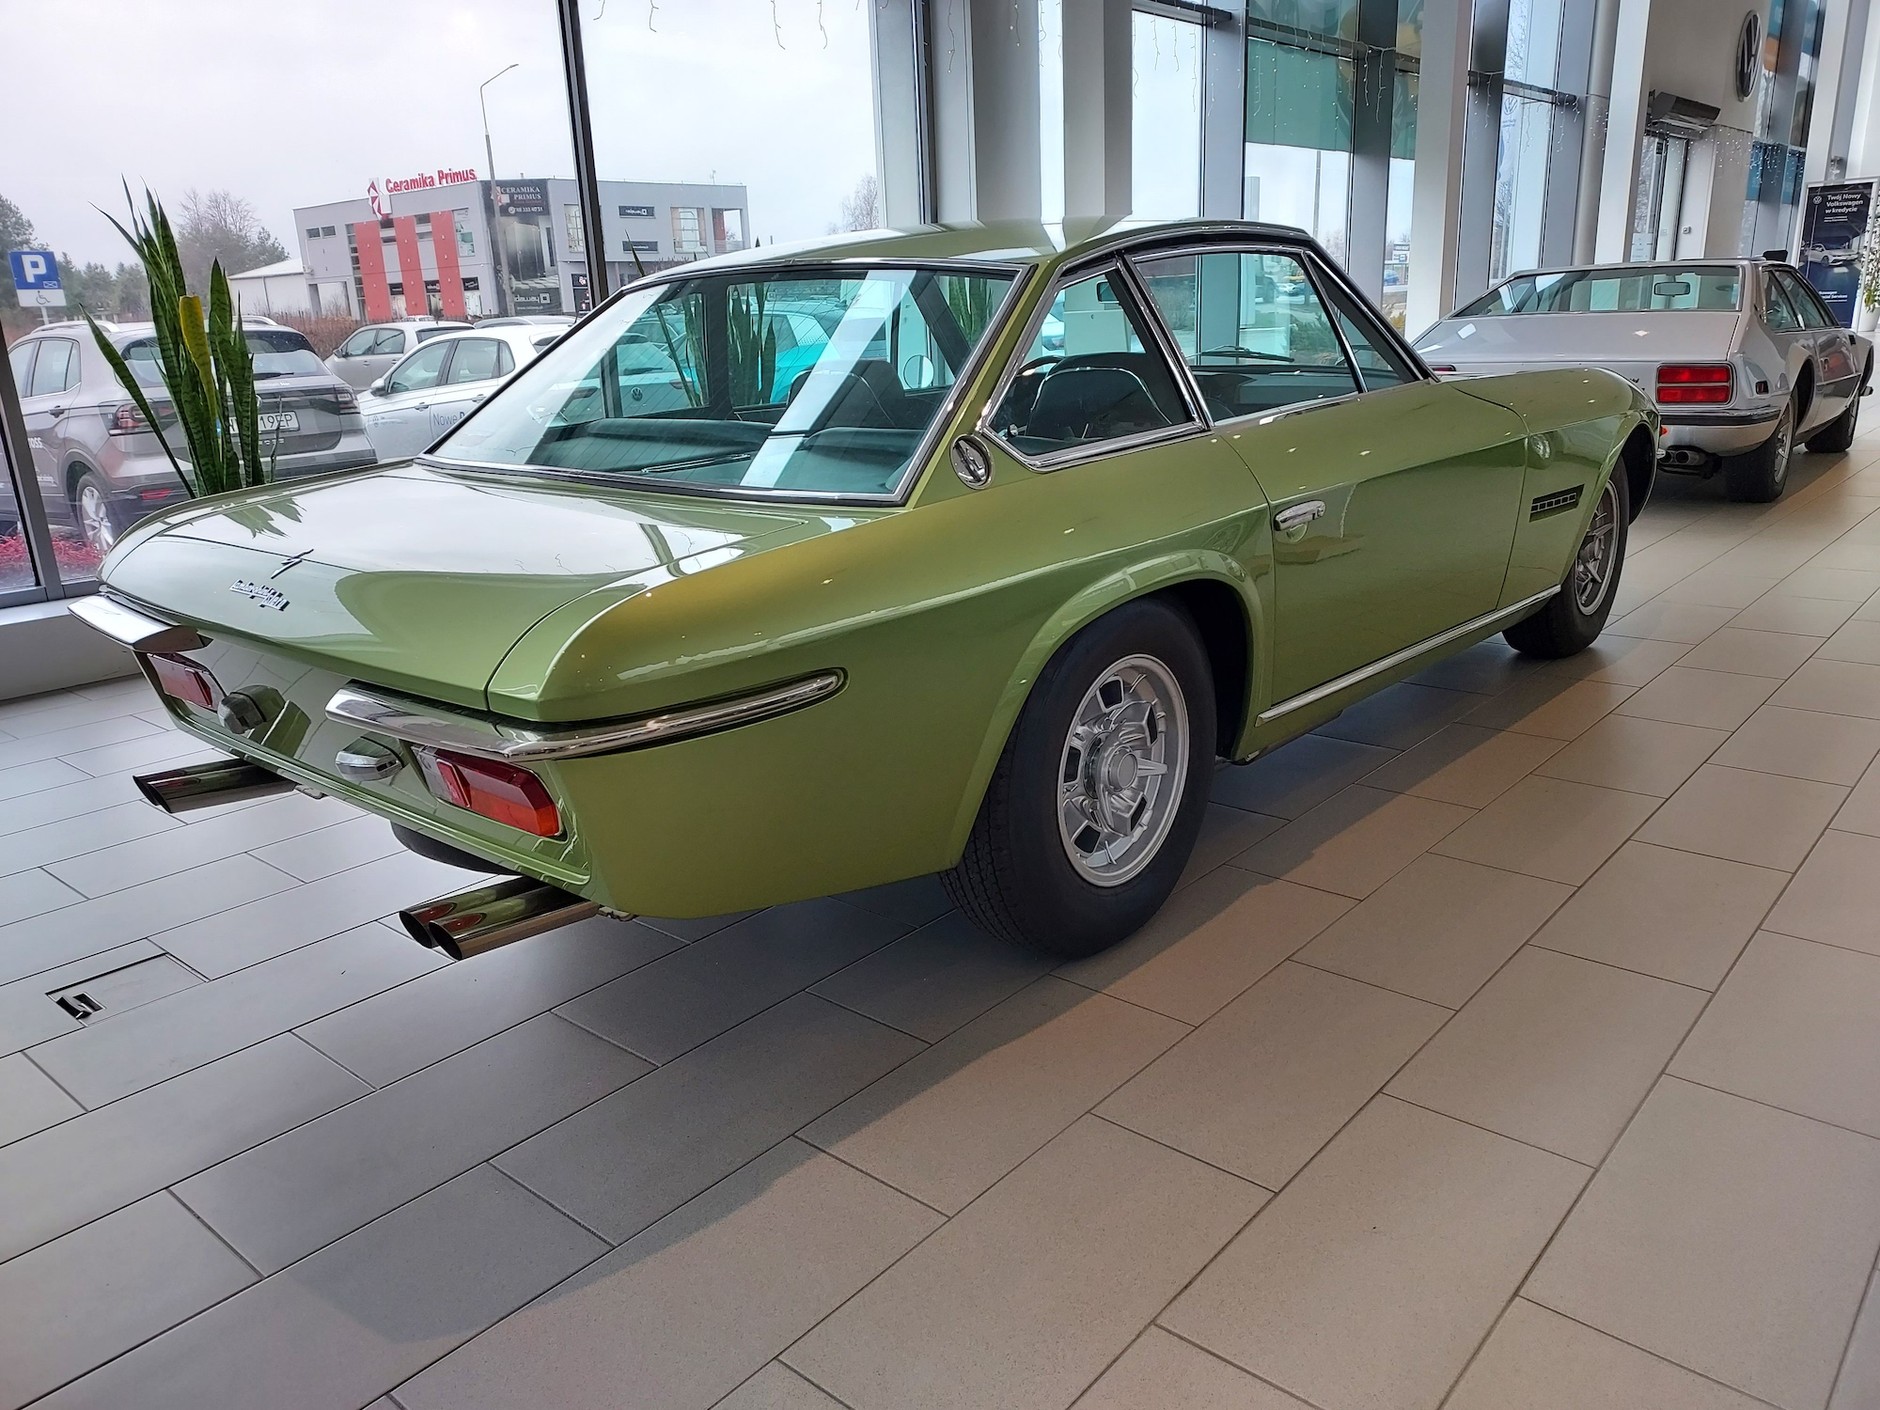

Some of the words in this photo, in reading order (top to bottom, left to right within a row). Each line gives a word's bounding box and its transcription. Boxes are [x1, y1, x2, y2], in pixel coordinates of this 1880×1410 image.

[385, 173, 435, 193] Ceramika
[437, 168, 478, 185] Primus
[501, 186, 541, 194] CERAMIKA
[21, 254, 47, 283] P
[433, 412, 458, 426] Nowe
